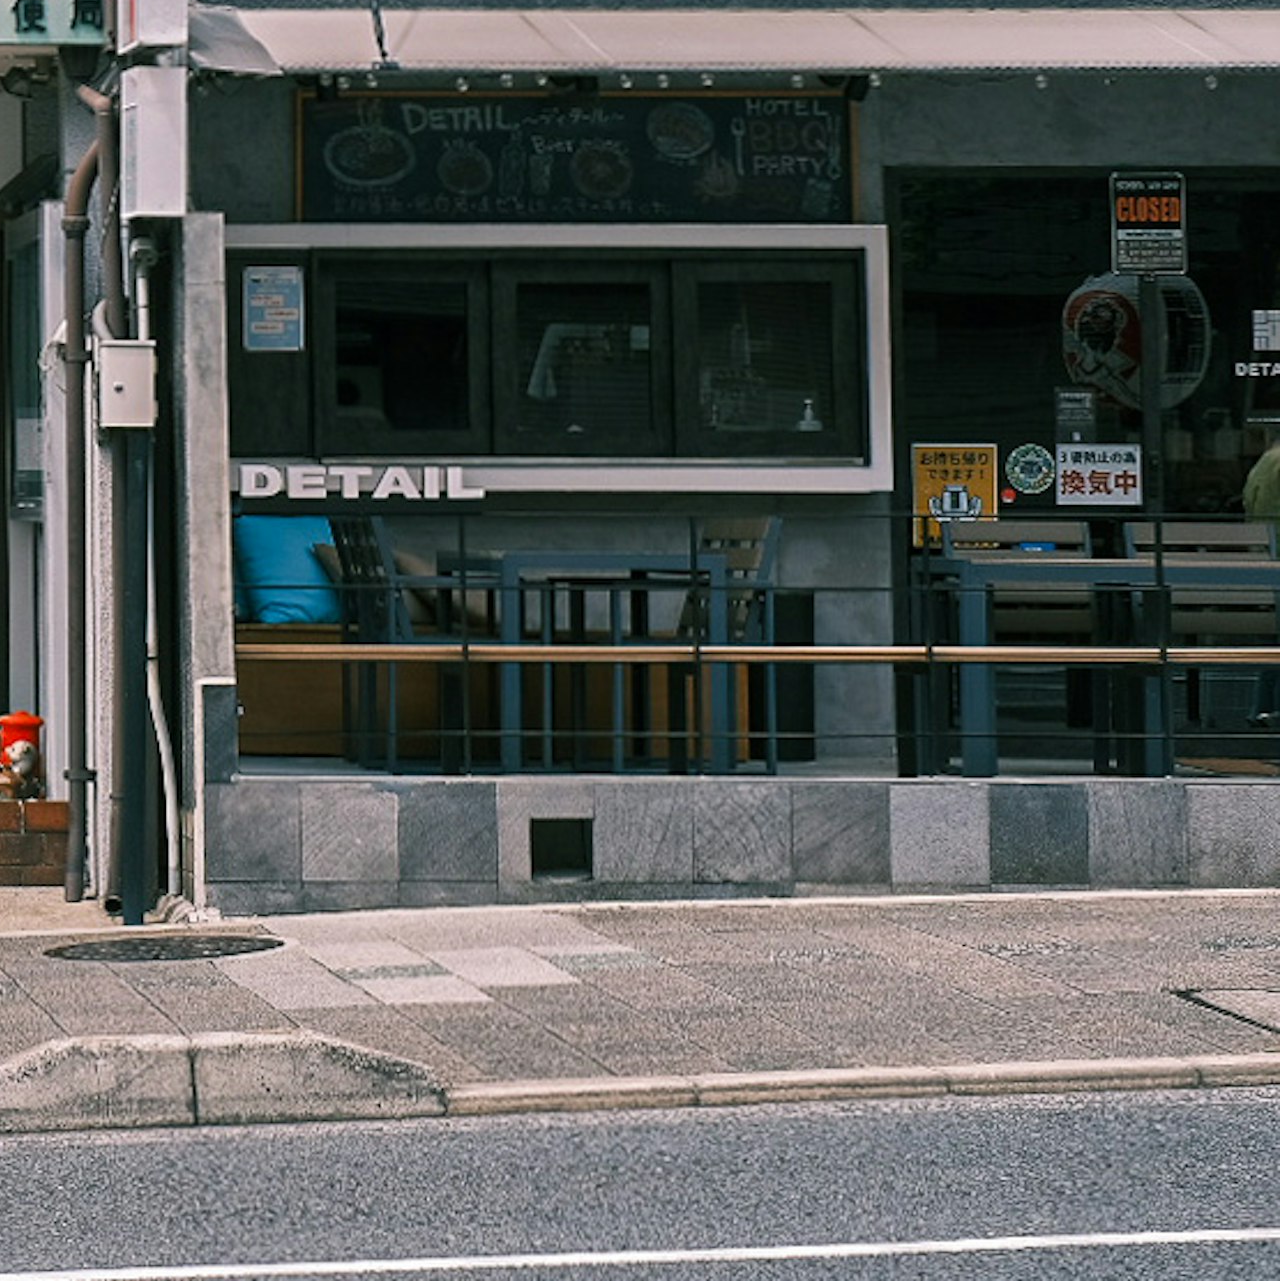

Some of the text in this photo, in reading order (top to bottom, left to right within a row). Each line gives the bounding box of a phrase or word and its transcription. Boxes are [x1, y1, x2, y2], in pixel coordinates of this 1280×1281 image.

[744, 98, 830, 117] HOTEL
[748, 119, 828, 153] BBQ
[751, 154, 827, 176] PARTY
[1115, 195, 1181, 224] CLOSED
[919, 451, 989, 466] お持ち帰り
[239, 463, 486, 500] DETAIL
[1060, 469, 1138, 495] 換気中
